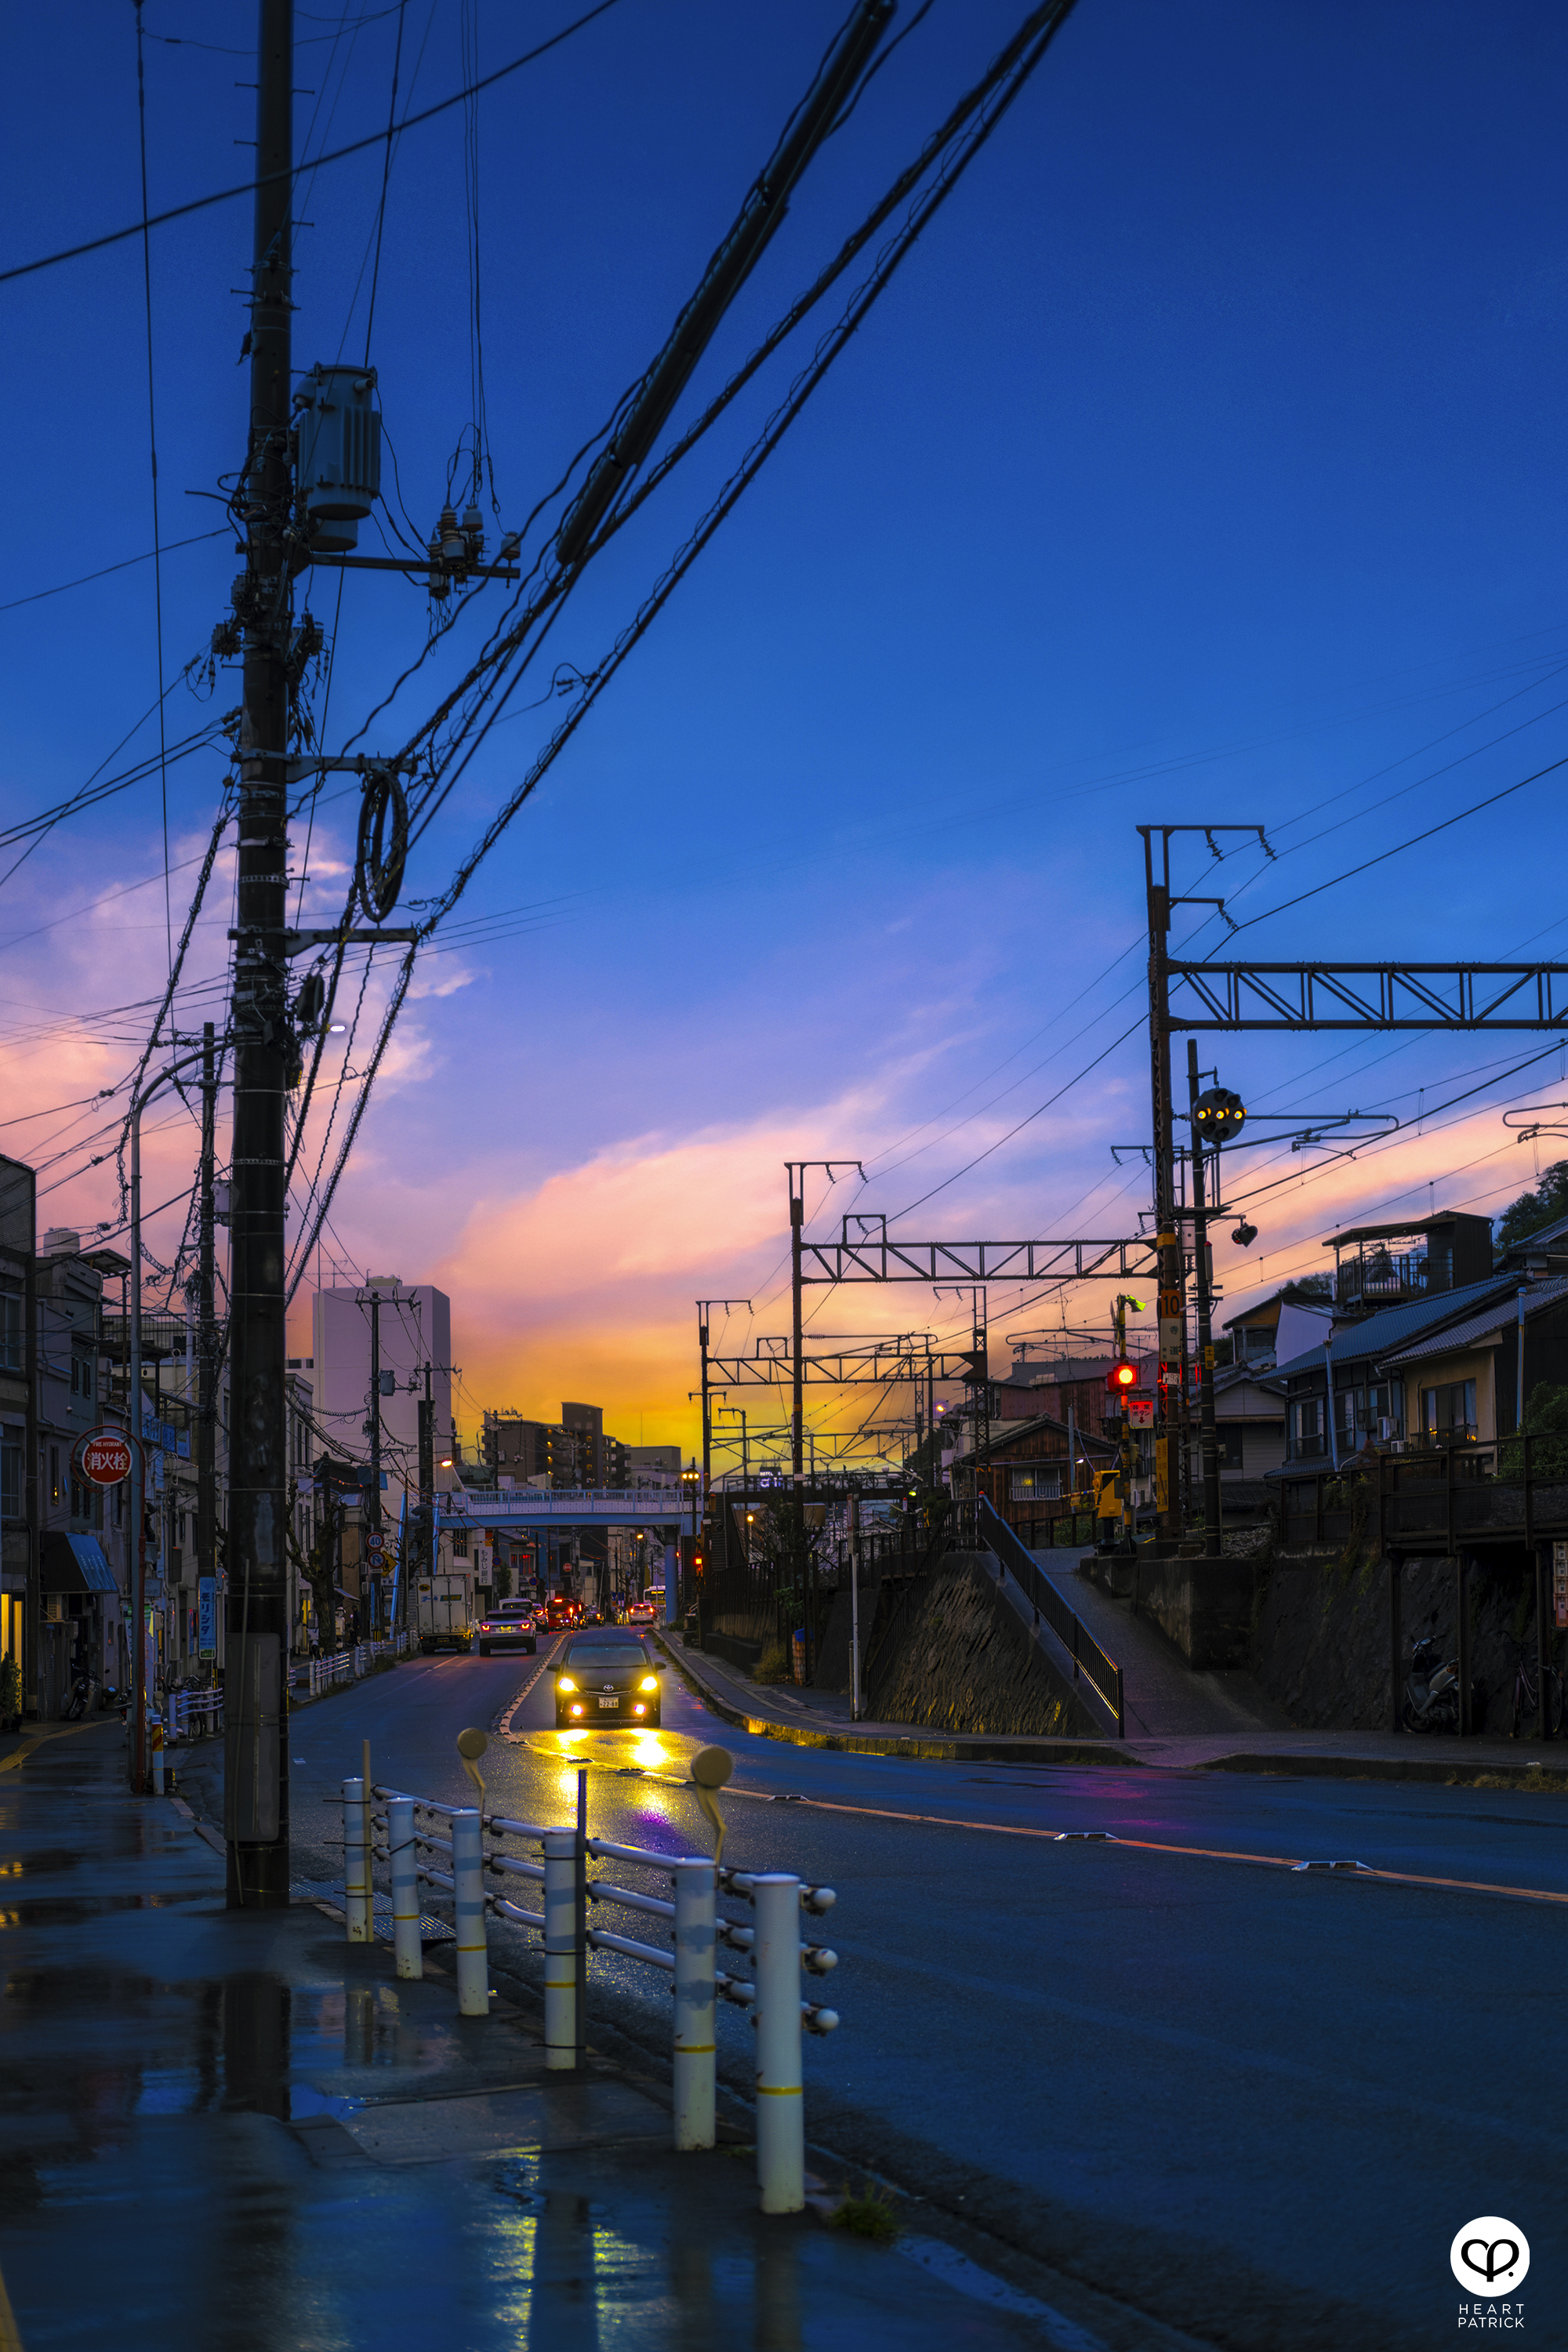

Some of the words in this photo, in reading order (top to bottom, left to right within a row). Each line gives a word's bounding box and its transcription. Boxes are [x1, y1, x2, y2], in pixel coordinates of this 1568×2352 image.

[1163, 1295, 1179, 1315] 10
[87, 1452, 128, 1470] 消火栓
[370, 1537, 381, 1545] 40
[201, 1592, 211, 1635] モリシタ
